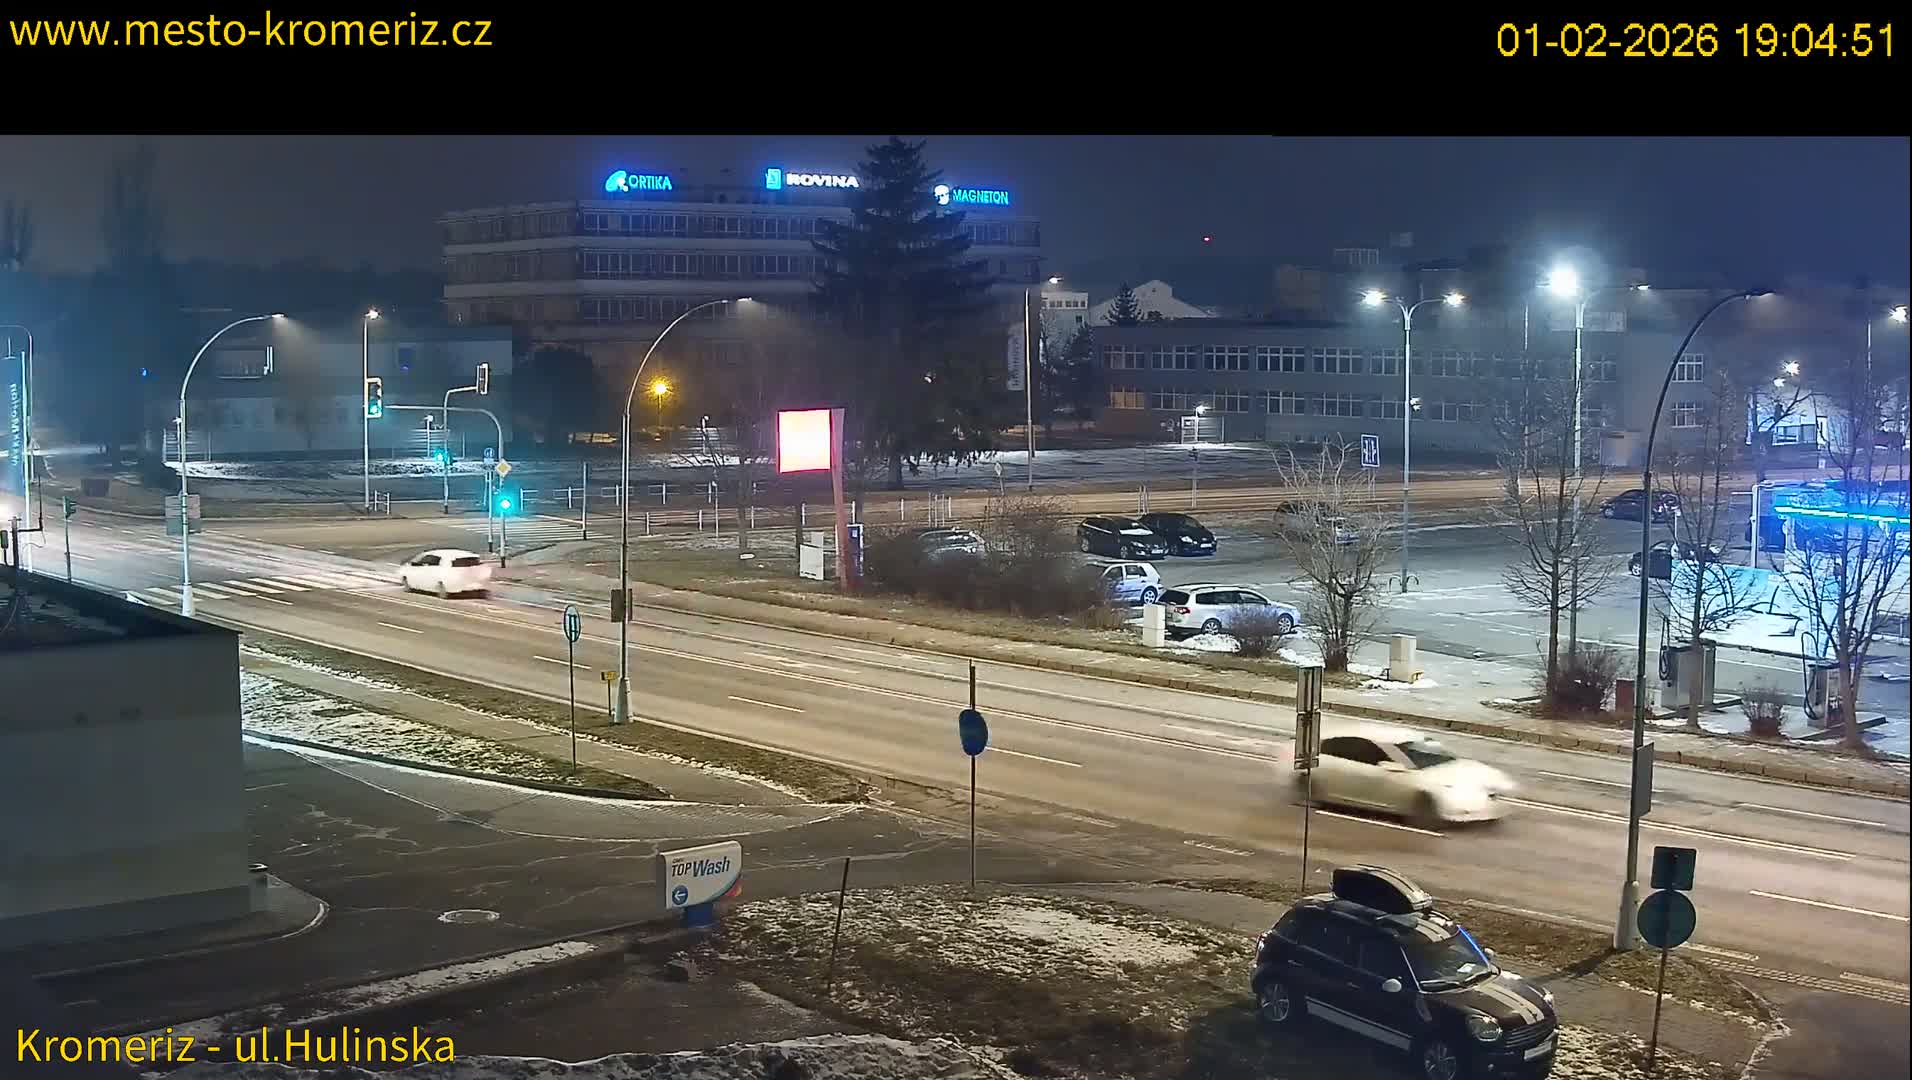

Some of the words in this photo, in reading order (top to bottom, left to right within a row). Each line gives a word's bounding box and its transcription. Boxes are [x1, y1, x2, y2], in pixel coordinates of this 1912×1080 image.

[628, 174, 673, 191] ORTIKA
[786, 172, 859, 188] ROVINA
[952, 188, 1009, 206] MAGNETON
